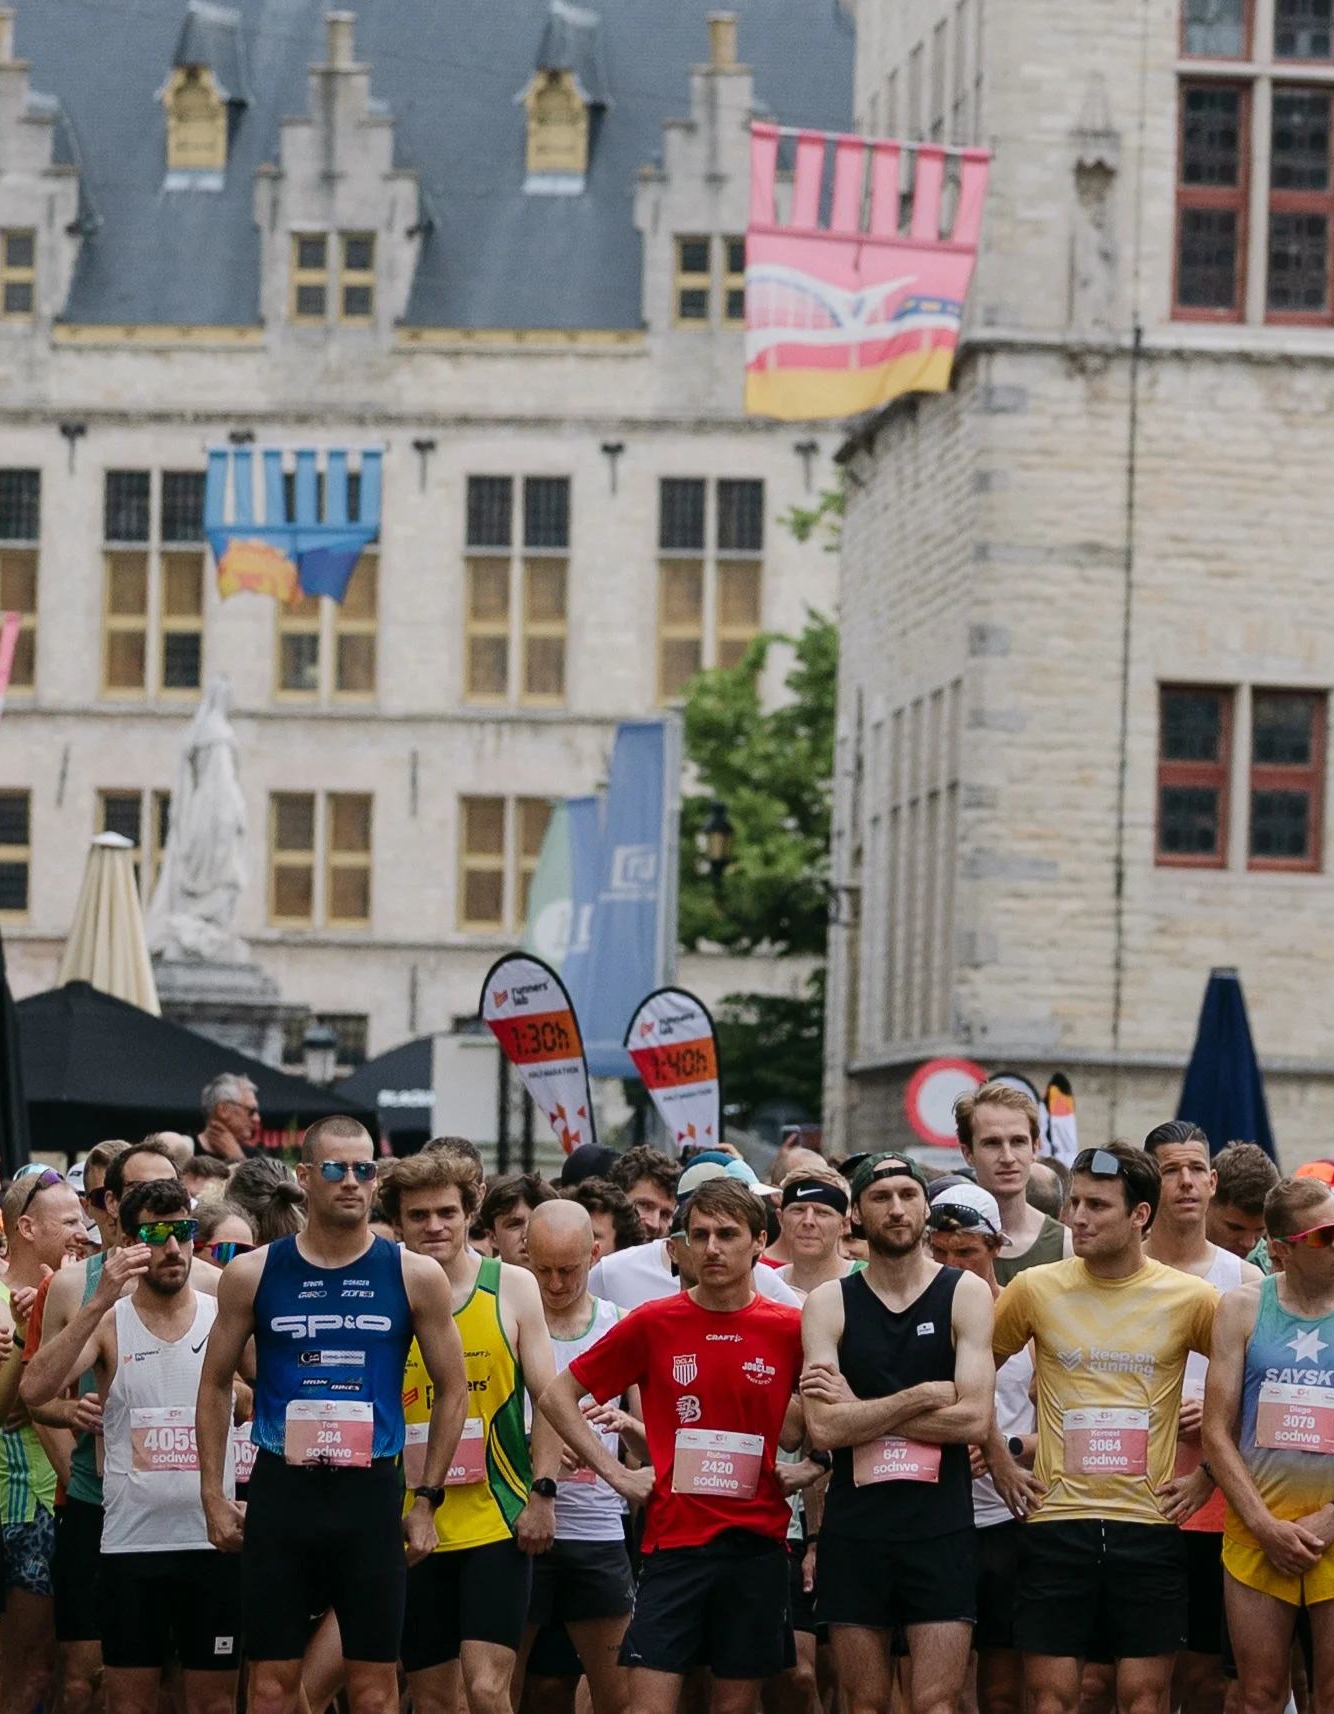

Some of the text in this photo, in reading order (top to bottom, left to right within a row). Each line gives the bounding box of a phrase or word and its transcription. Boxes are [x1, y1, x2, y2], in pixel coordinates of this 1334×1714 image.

[512, 993, 529, 1006] lab
[510, 1021, 571, 1056] 1:30h
[650, 1048, 708, 1081] 1:40h
[270, 1314, 392, 1339] SP&O
[1090, 1360, 1155, 1379] running
[322, 1421, 339, 1429] Tom
[1282, 1414, 1316, 1429] 3079
[316, 1430, 342, 1444] 284
[1274, 1429, 1321, 1444] sodiwe
[306, 1445, 352, 1458] sodiwe
[1088, 1438, 1122, 1452] 3064
[152, 1450, 198, 1464] sodiwe
[883, 1448, 908, 1460] 647
[1082, 1453, 1128, 1466] sodiwe
[700, 1460, 734, 1475] 2420
[873, 1460, 919, 1475] sodiwe
[693, 1475, 739, 1489] sodiwe
